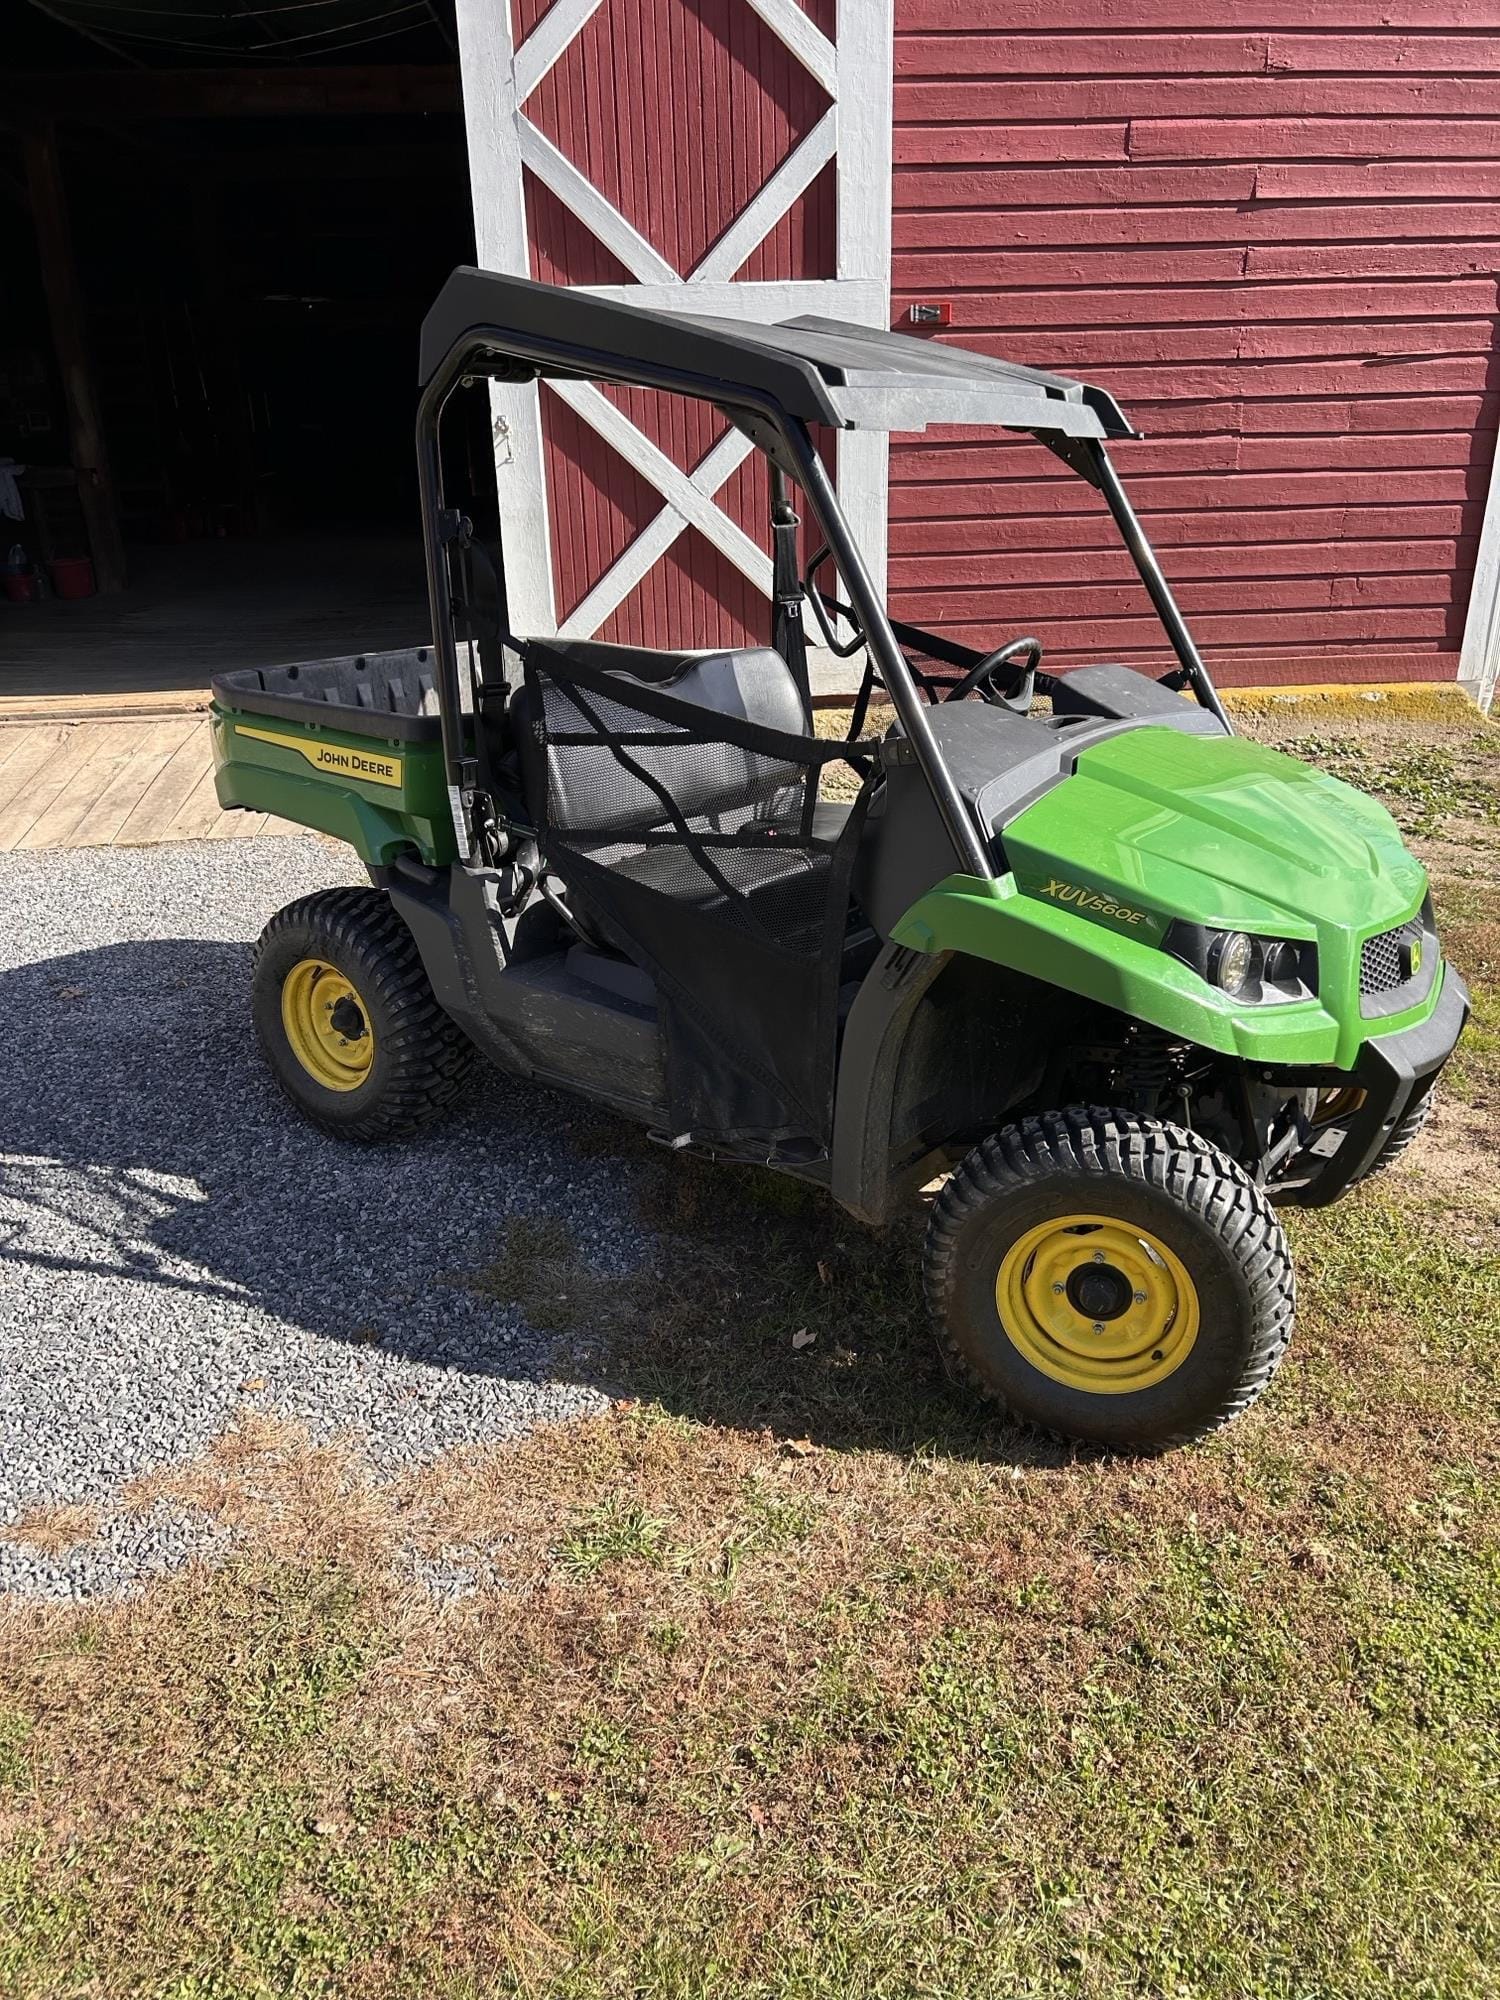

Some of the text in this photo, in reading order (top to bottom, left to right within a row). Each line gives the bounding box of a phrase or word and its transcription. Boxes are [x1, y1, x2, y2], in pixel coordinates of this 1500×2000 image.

[317, 749, 393, 777] JOHN DEERE
[1040, 879, 1145, 924] XUV560E
